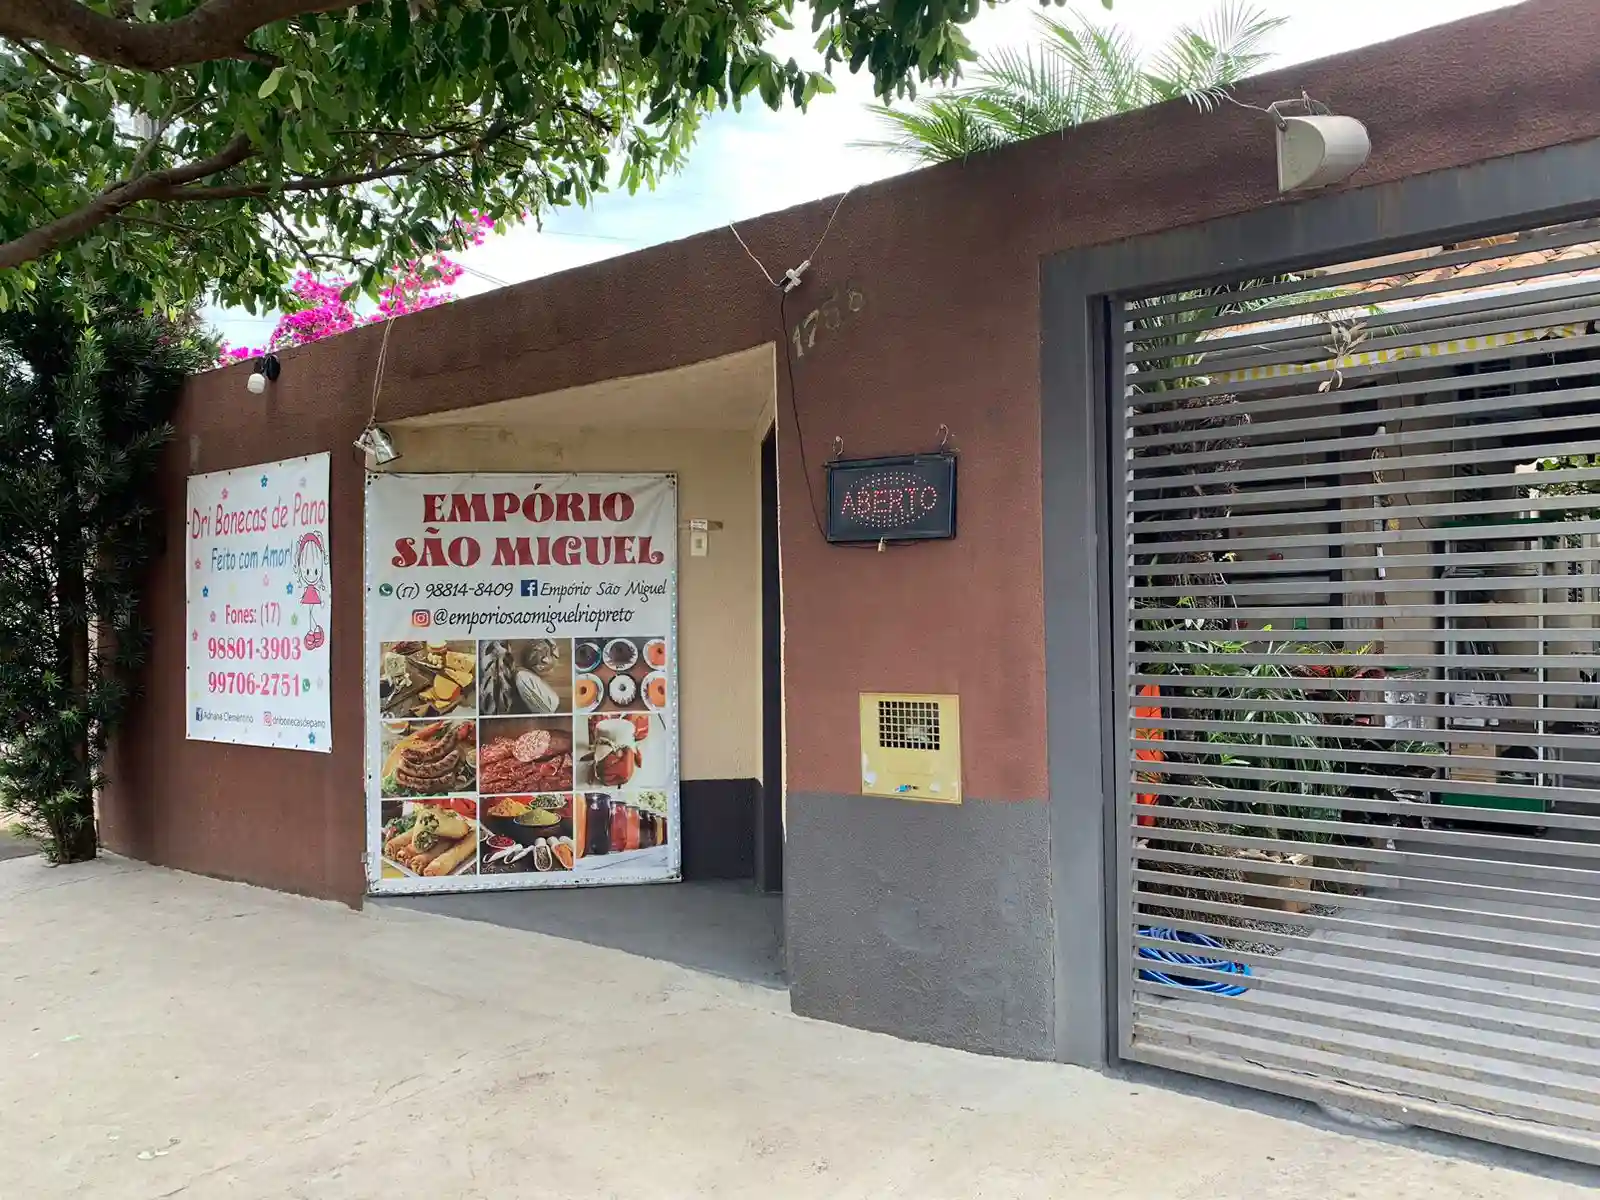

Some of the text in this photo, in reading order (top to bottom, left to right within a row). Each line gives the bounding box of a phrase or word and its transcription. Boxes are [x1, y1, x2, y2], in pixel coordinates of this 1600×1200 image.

[192, 492, 326, 539] Dri Bonecas de Pano
[423, 483, 635, 523] EMPÓRIO
[841, 486, 938, 516] ABERTO
[211, 541, 293, 572] Feito com Amor!
[391, 527, 665, 567] SÃO MIGUEL
[396, 579, 667, 602] (17) 98814-8409 Empório São Miguel
[226, 601, 281, 627] Fones: (17)
[433, 604, 634, 633] @emporiosaomiguelriopreto
[208, 637, 301, 660] 98801-3903
[208, 672, 300, 697] 99706-2751
